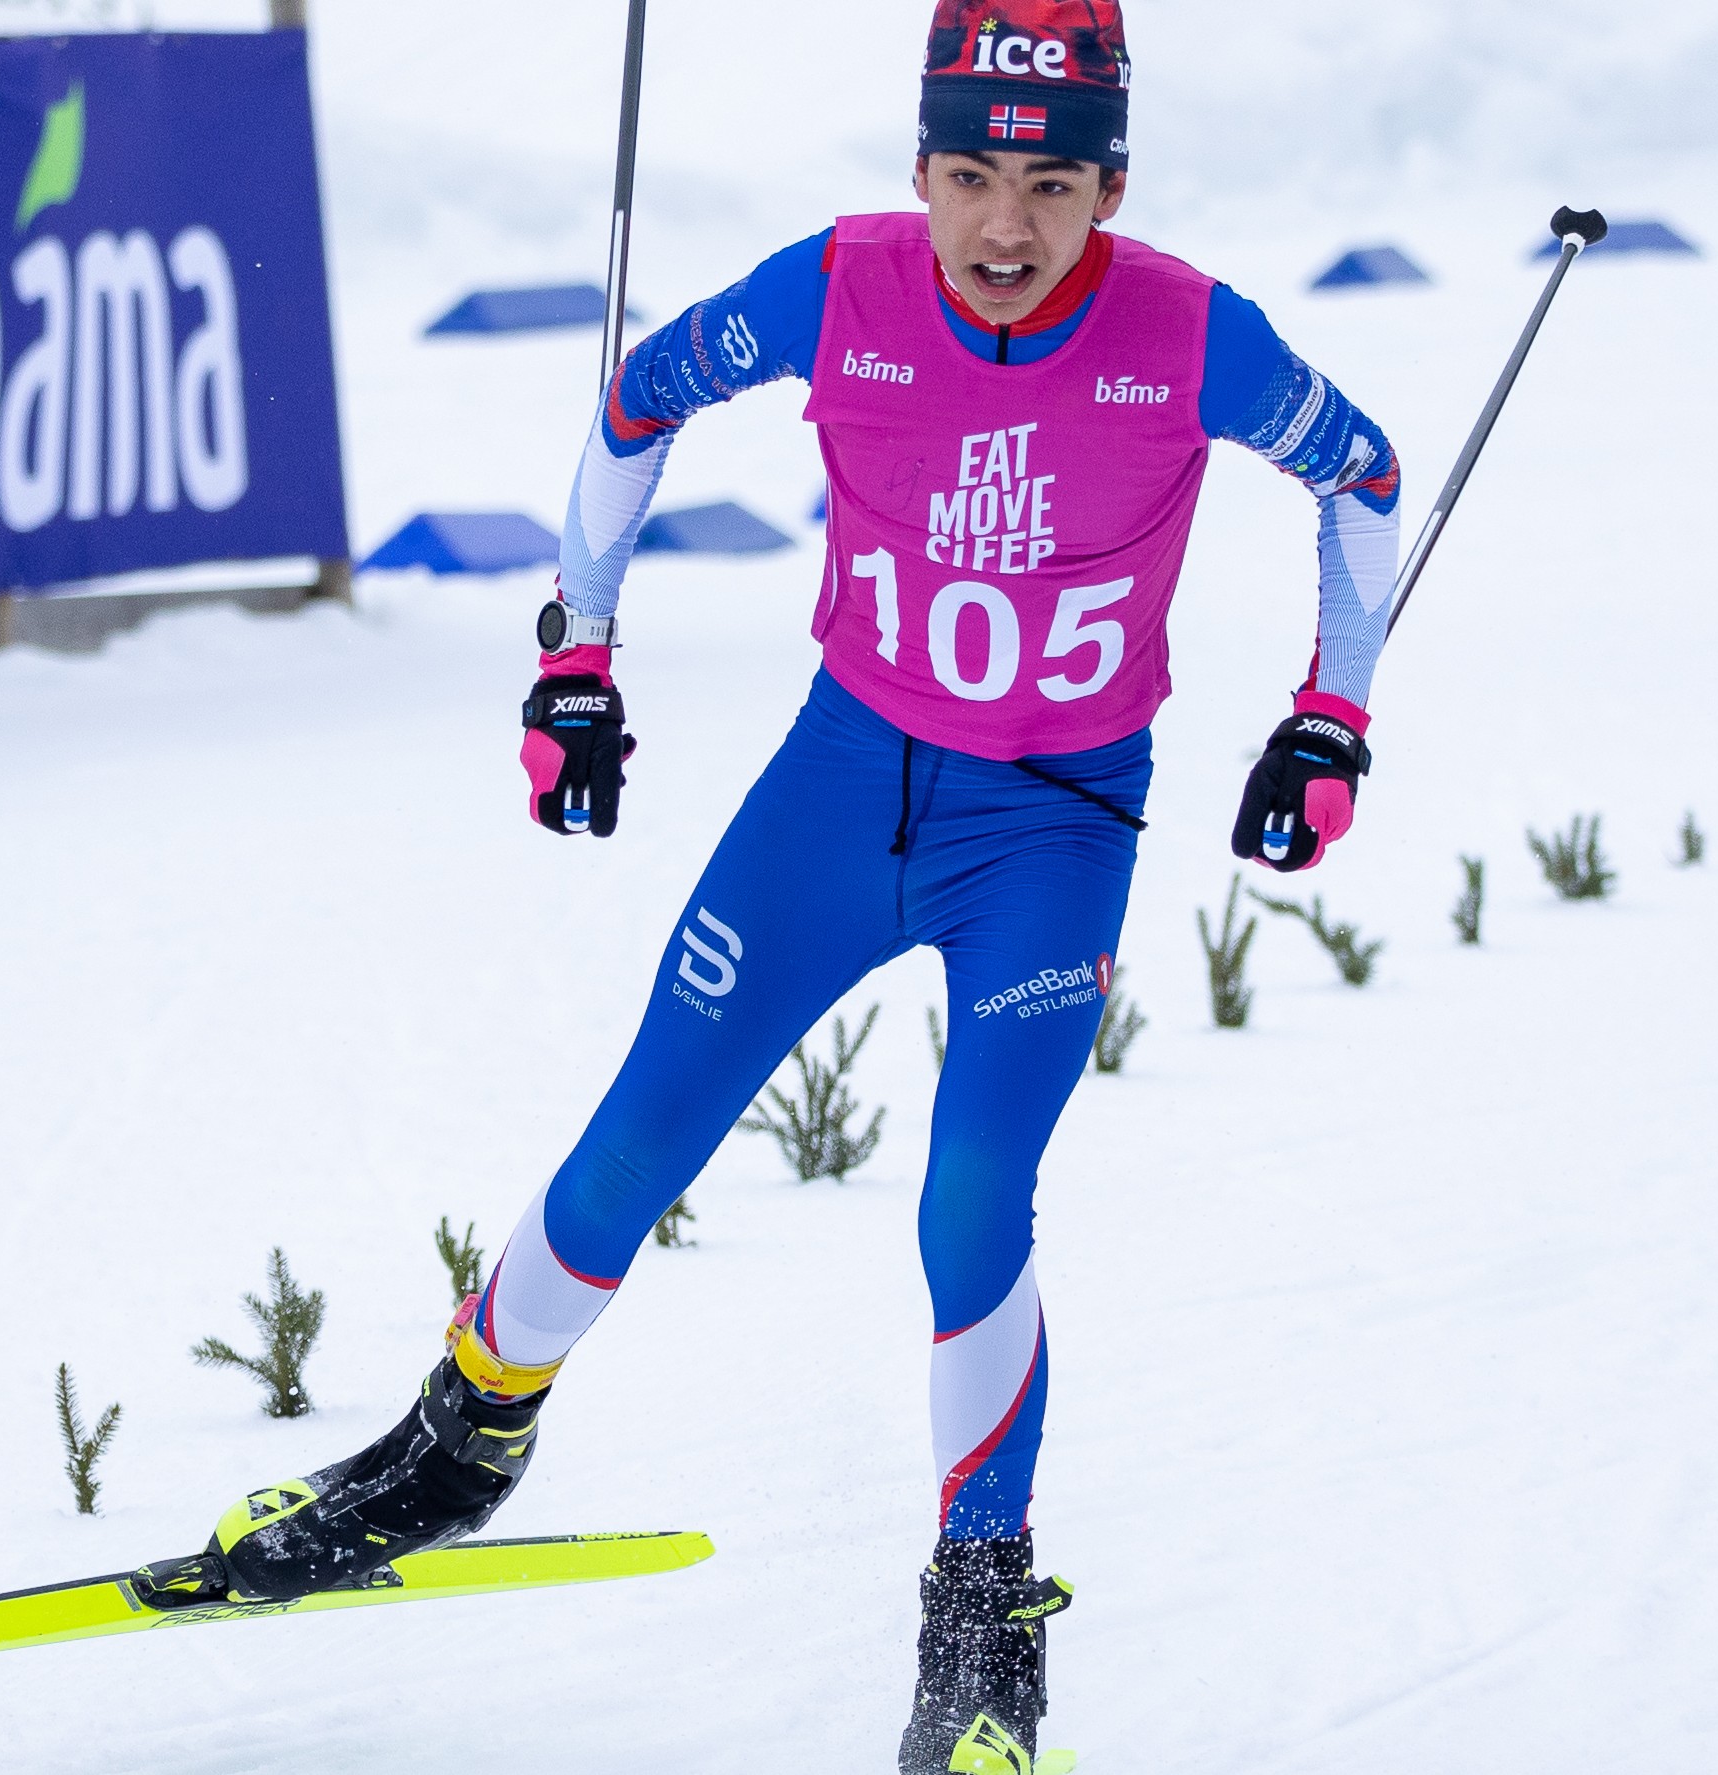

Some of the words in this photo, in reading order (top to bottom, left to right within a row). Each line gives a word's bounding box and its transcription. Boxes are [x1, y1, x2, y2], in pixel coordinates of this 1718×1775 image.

[973, 33, 1066, 79] ice
[842, 350, 915, 385] bama
[1094, 376, 1170, 404] bama
[958, 422, 1037, 491] EAT
[928, 475, 1055, 541] MOVE
[851, 546, 1134, 702] 105
[550, 696, 610, 714] SWIX
[1296, 719, 1354, 746] SWIX
[672, 982, 722, 1021] DÆHLIE
[974, 961, 1095, 1018] SpareBank
[1100, 960, 1109, 988] 1
[1017, 987, 1098, 1019] ØSTLANDET
[1007, 1596, 1063, 1620] FISCHER
